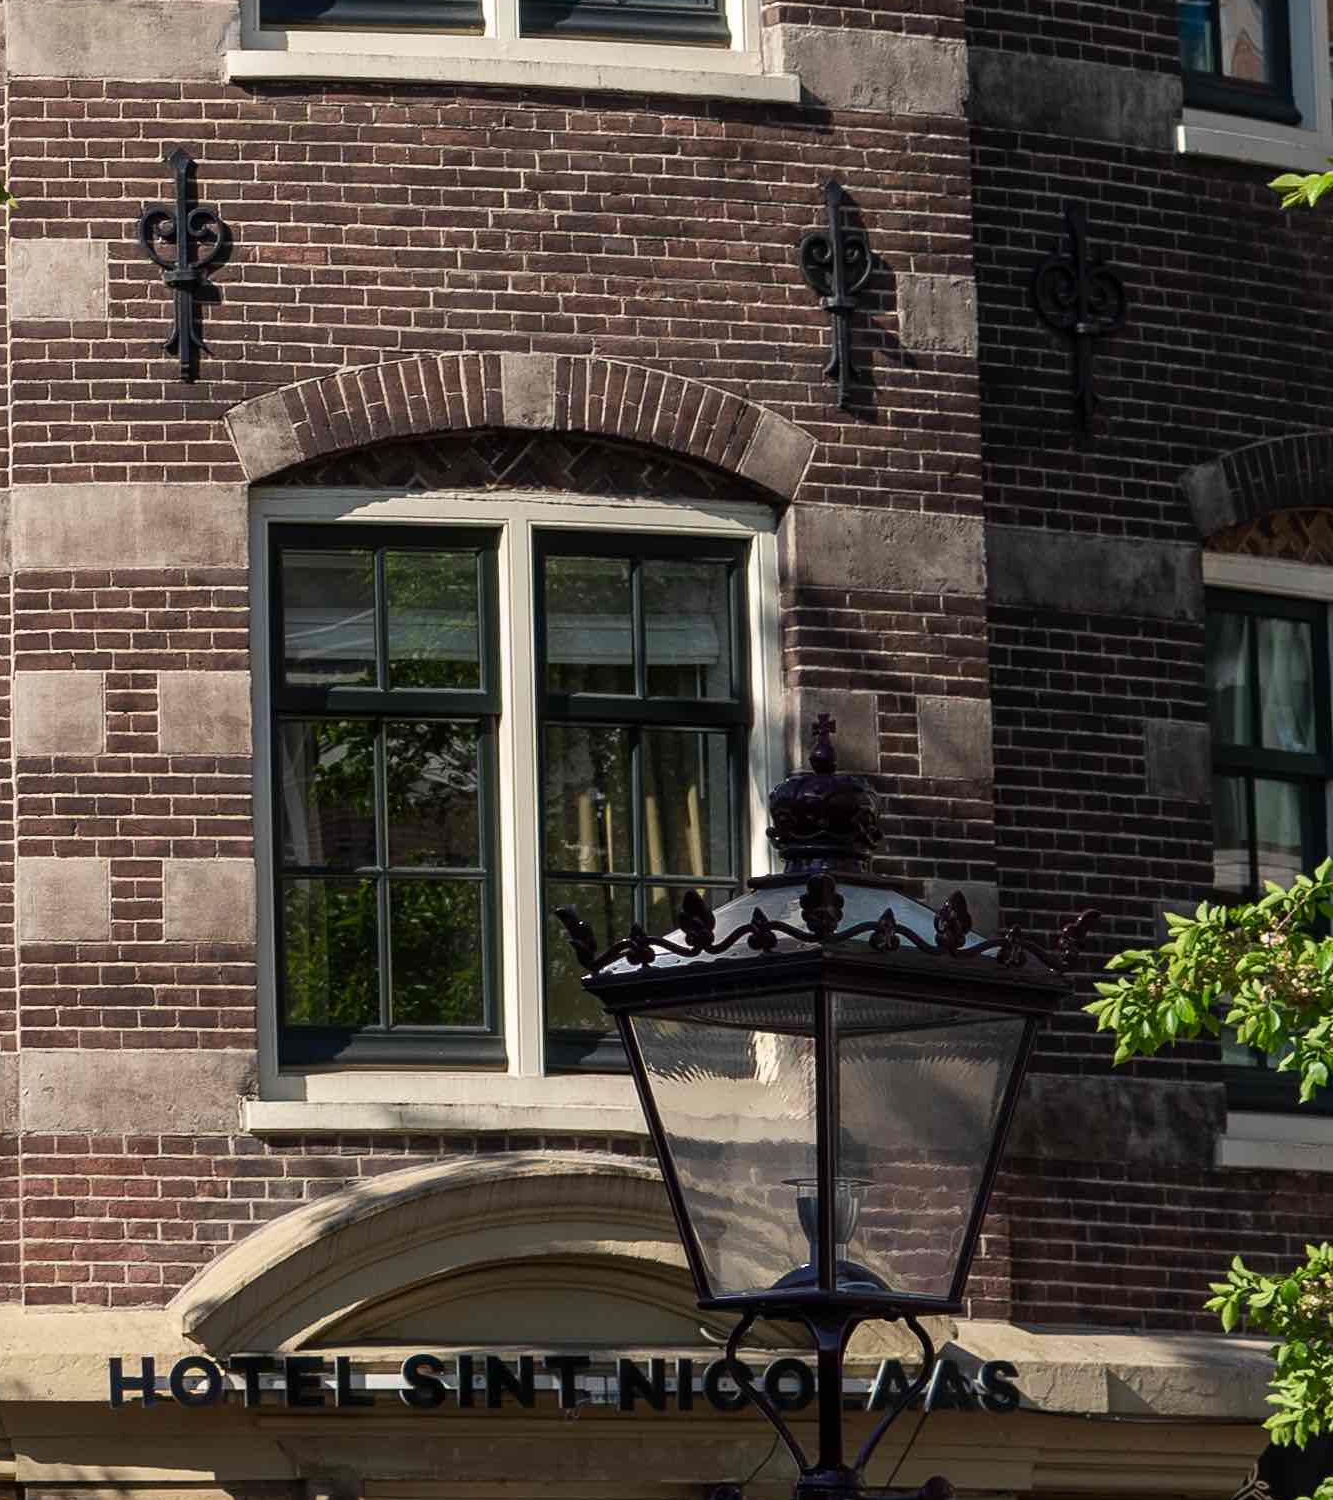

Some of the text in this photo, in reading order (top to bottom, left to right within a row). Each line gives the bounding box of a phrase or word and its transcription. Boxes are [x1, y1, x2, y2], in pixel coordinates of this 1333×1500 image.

[109, 1353, 1020, 1413] HOTEL SINT NICOAAS
